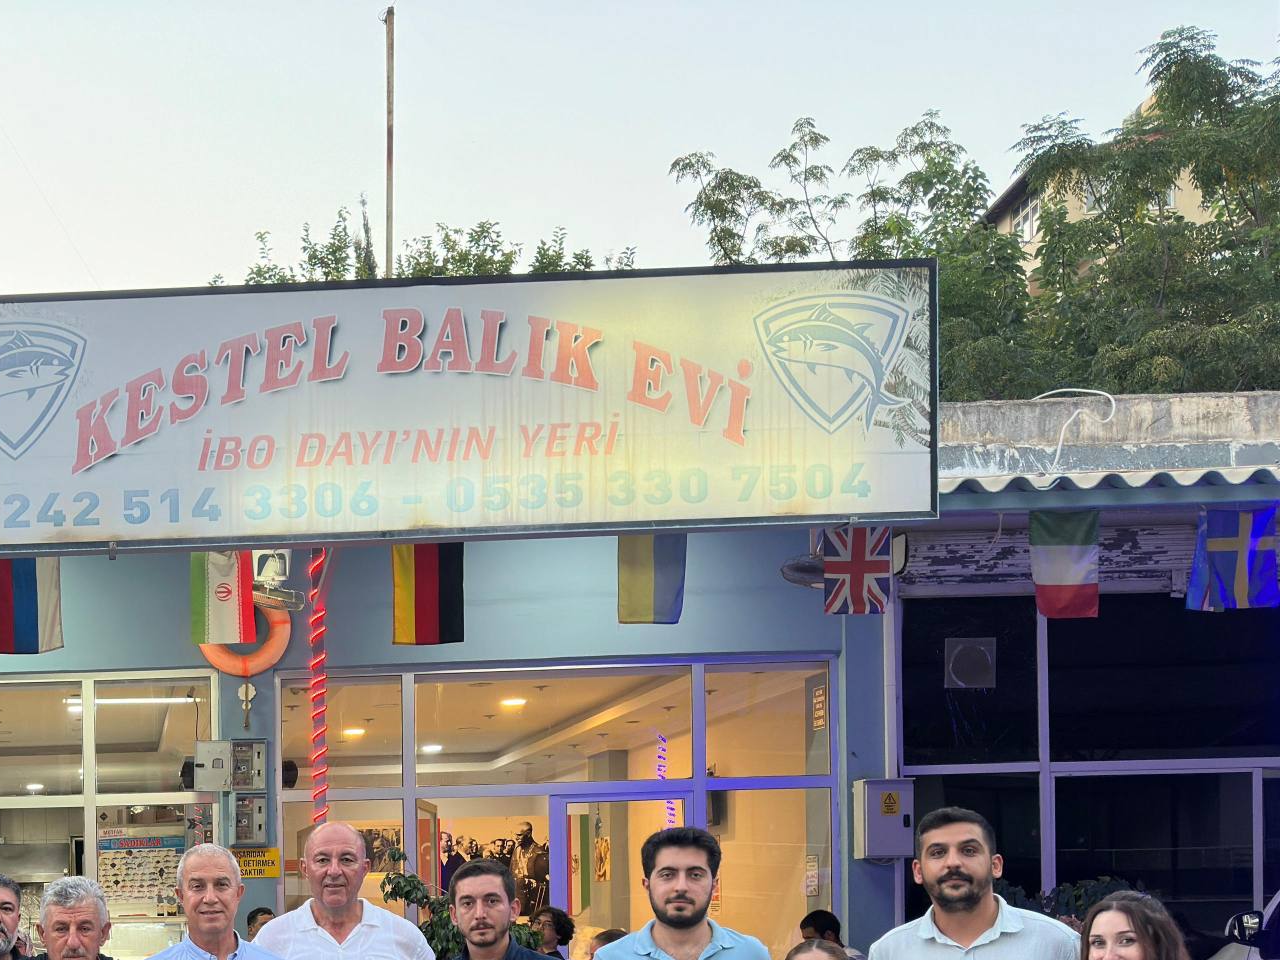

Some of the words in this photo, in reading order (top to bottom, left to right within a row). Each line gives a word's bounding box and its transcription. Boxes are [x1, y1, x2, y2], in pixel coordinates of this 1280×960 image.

[72, 314, 350, 475] KESTEL
[376, 306, 605, 392] BALIK
[626, 340, 754, 448] EVİ
[197, 429, 277, 472] İBO
[295, 426, 496, 468] DAYI'NIN
[520, 412, 622, 459] YERİ
[123, 487, 222, 524] 514
[243, 480, 379, 521] 3306
[445, 471, 585, 513] 0535
[607, 467, 709, 506] 330
[730, 462, 872, 503] 7504
[240, 868, 266, 877] SAKTIR!
[243, 859, 276, 868] GETİRMEK
